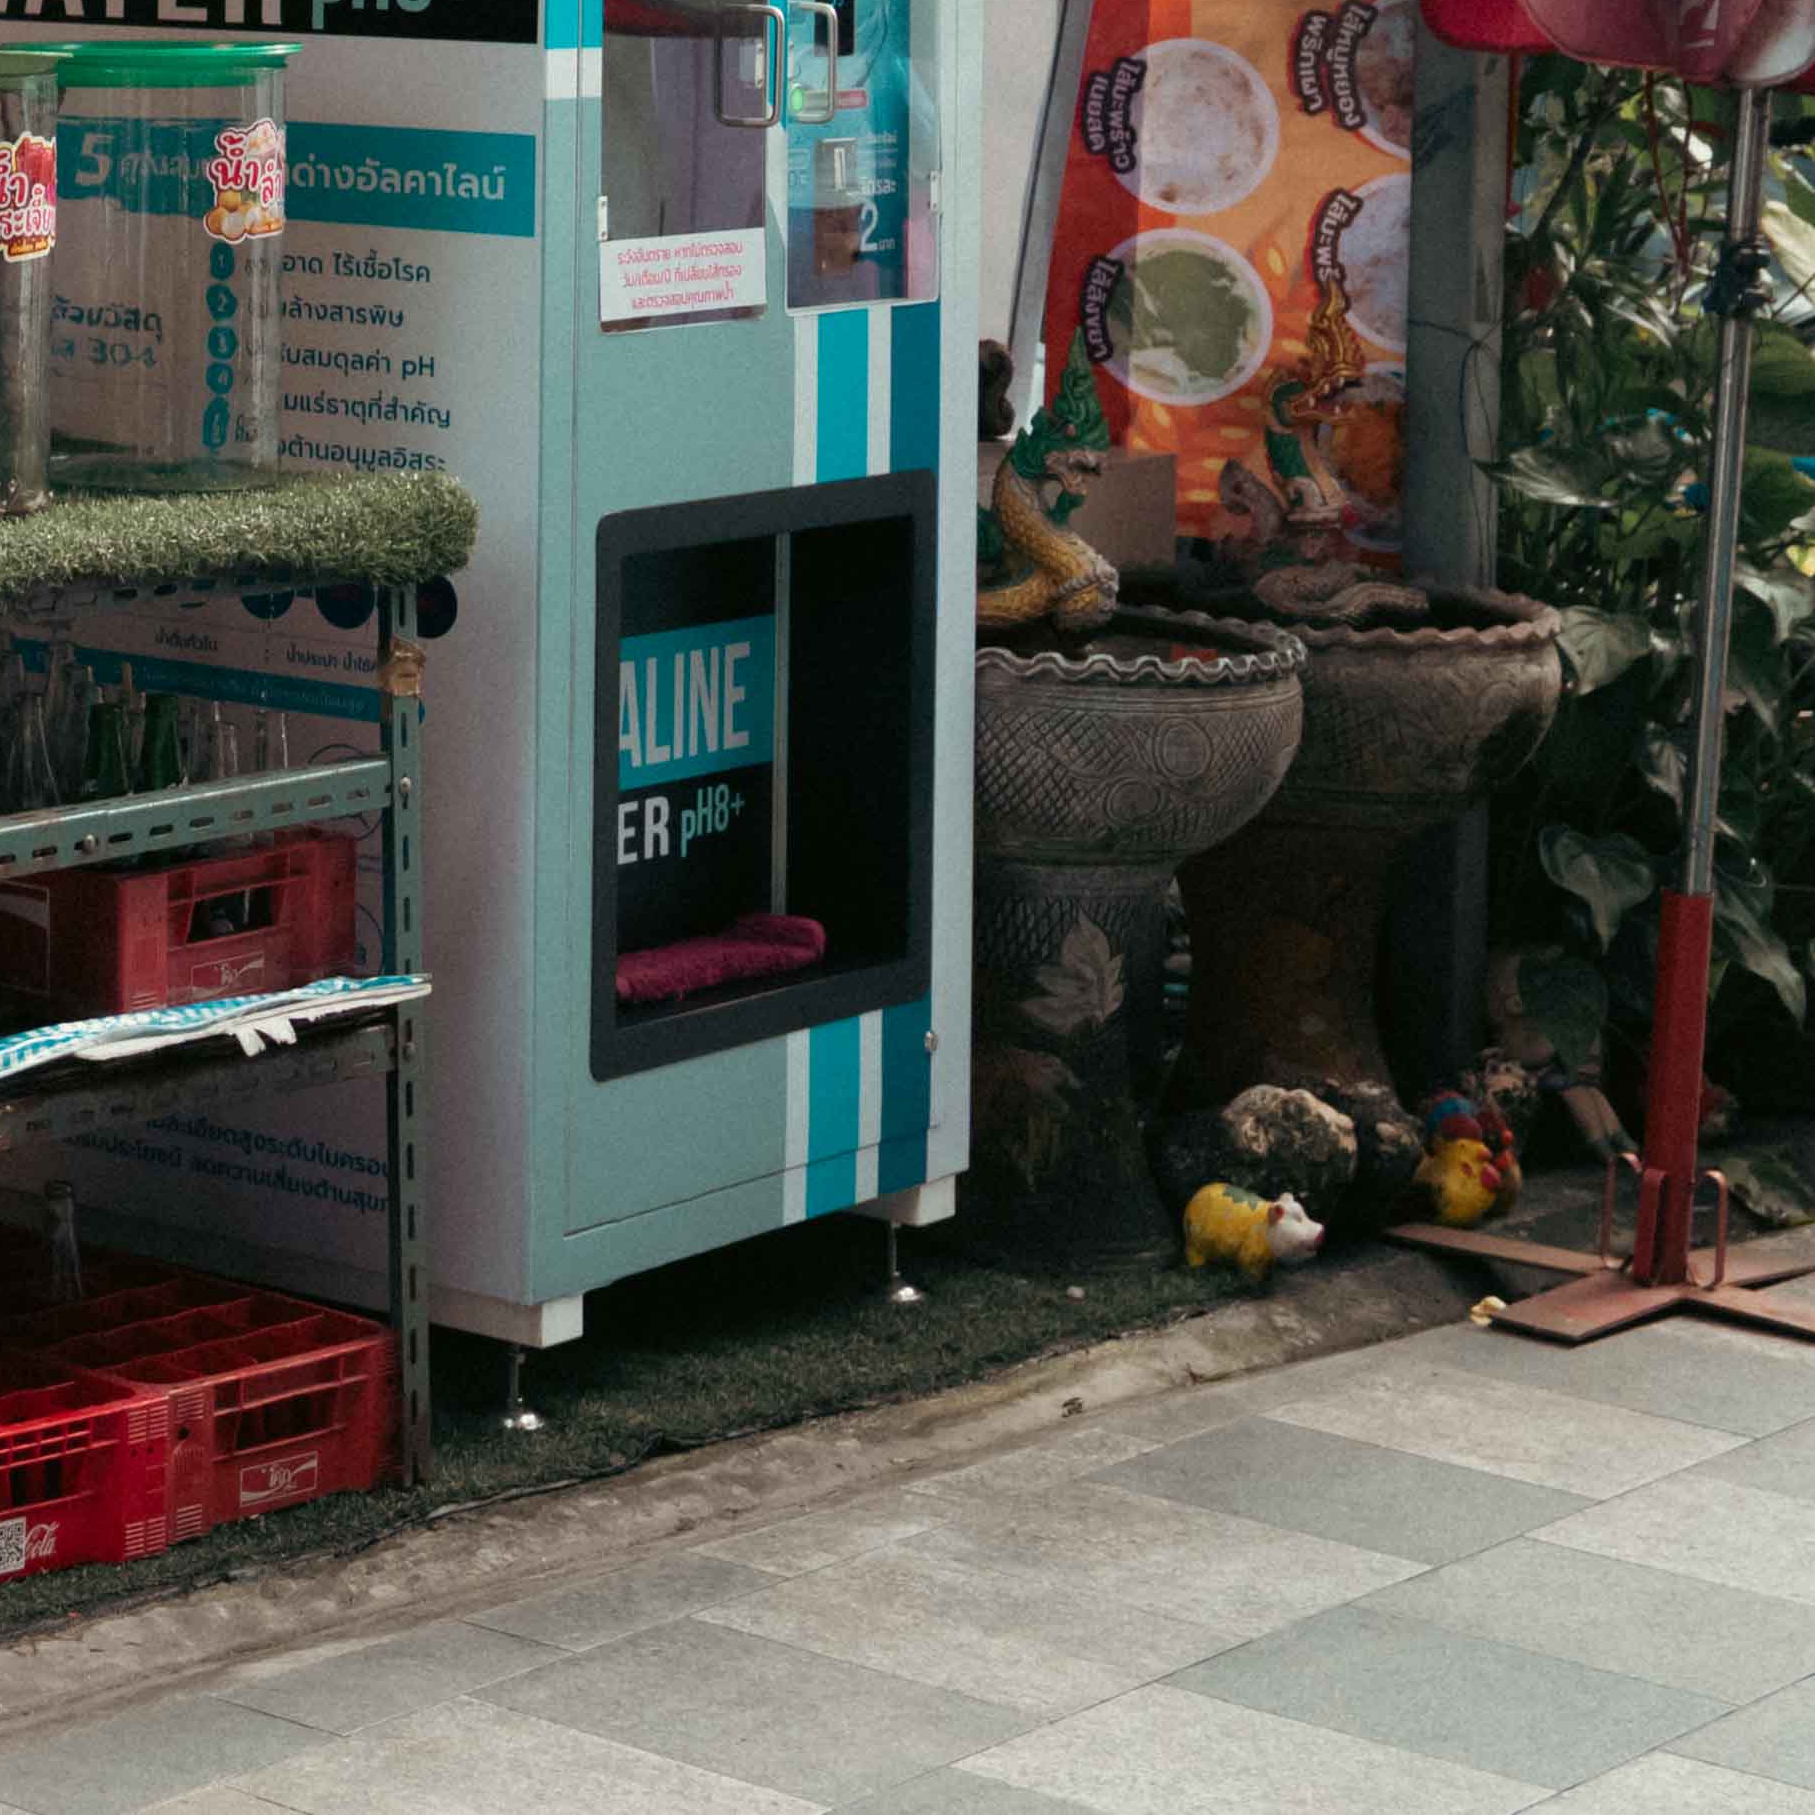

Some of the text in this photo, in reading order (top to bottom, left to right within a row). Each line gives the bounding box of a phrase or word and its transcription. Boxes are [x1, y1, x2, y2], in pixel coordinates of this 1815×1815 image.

[75, 134, 114, 186] 5
[213, 134, 260, 186] น้ำ
[859, 201, 881, 253] 2
[333, 250, 431, 284] ไร้เชื้อโรค
[401, 357, 436, 380] pH
[680, 784, 746, 858] pH8+
